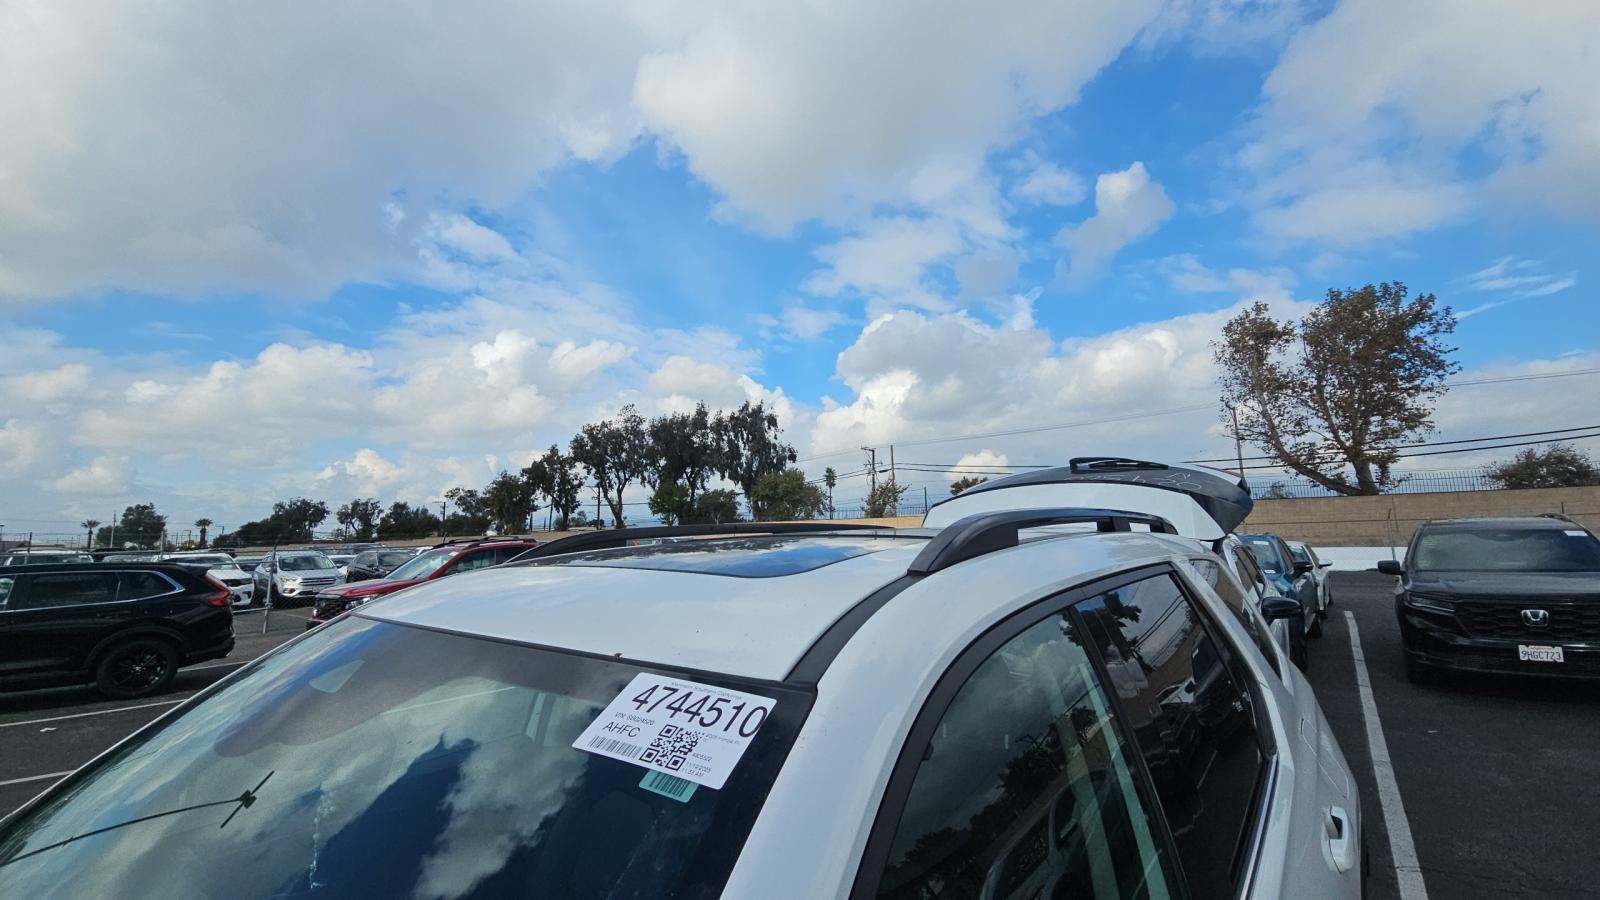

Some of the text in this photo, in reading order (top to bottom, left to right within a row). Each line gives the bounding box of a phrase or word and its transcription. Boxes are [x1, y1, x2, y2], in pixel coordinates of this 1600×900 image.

[1521, 650, 1561, 660] 9HGC723
[631, 684, 768, 738] 4744510
[602, 721, 641, 738] AHFC
